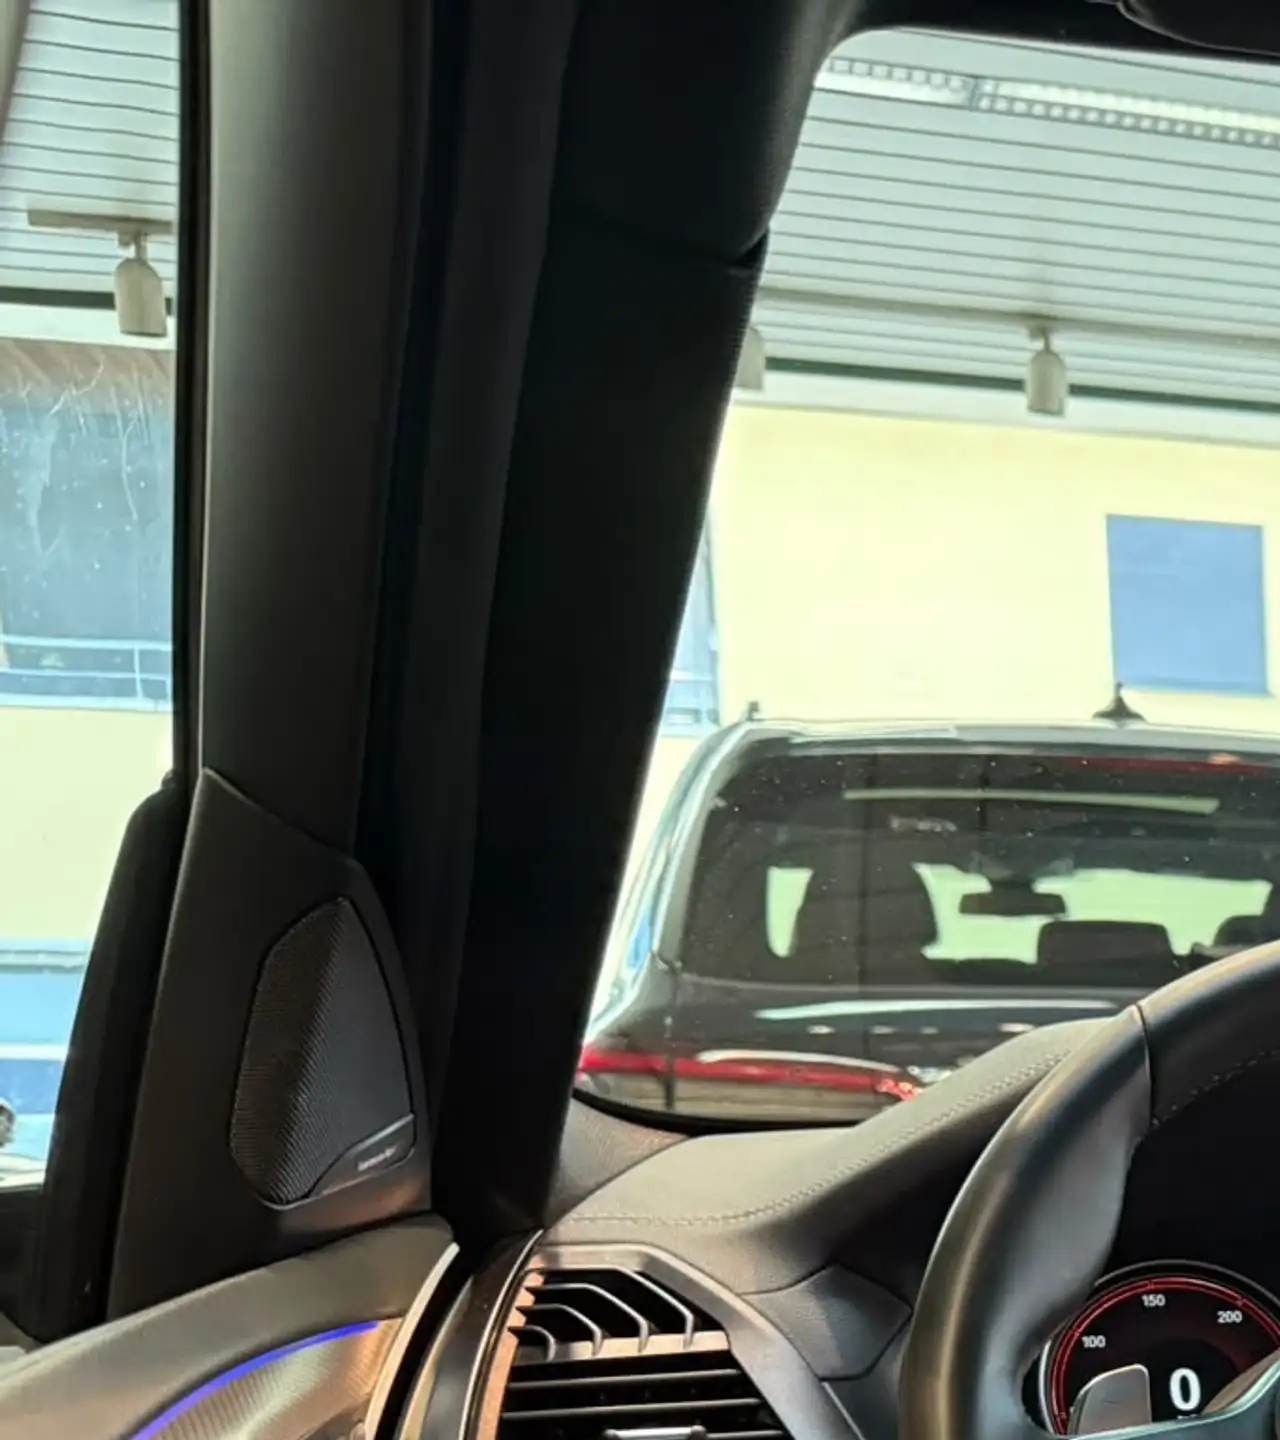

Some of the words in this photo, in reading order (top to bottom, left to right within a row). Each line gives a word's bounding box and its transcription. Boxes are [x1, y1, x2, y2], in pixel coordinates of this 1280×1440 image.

[1142, 1294, 1165, 1307] 150
[1217, 1310, 1242, 1323] 200
[1081, 1335, 1106, 1348] 100
[1169, 1367, 1200, 1411] 0
